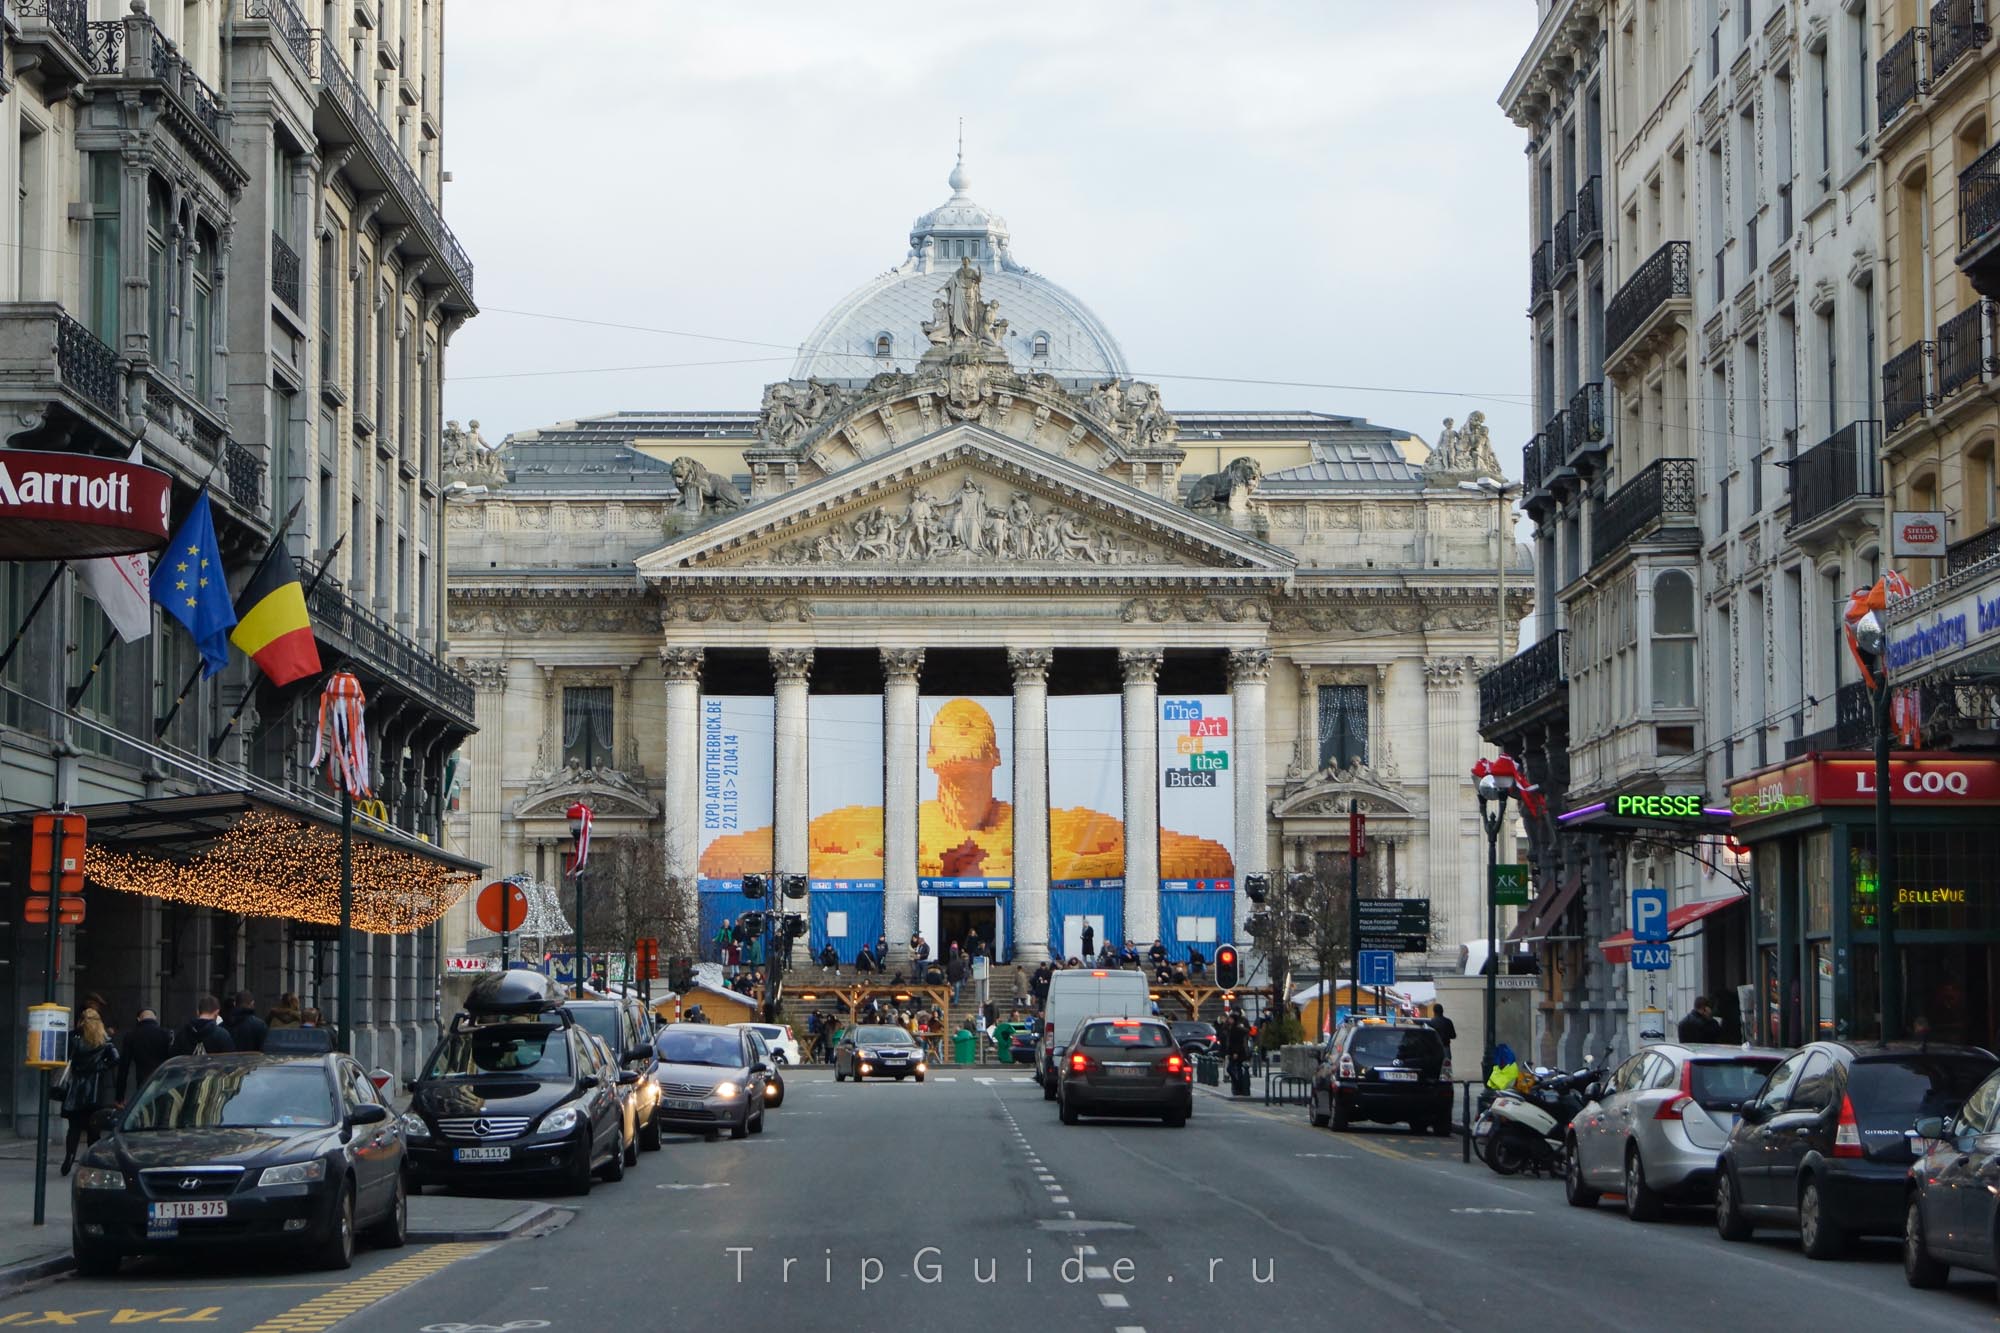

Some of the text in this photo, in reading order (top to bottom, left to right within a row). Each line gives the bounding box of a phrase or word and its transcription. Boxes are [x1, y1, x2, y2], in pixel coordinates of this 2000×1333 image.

[1166, 705, 1199, 719] The
[1196, 721, 1222, 736] Art
[1182, 738, 1198, 753] of
[723, 735, 738, 775] 21.04.14
[1196, 755, 1223, 769] the
[705, 700, 722, 829] EXPO-ARTOFTHEBRICK.BE
[1170, 772, 1212, 787] Brick
[1903, 772, 1968, 794] COQ
[723, 790, 738, 829] 22.11.13
[1618, 795, 1700, 815] PRESSE
[1637, 897, 1662, 932] P
[1633, 950, 1670, 964] TAXI
